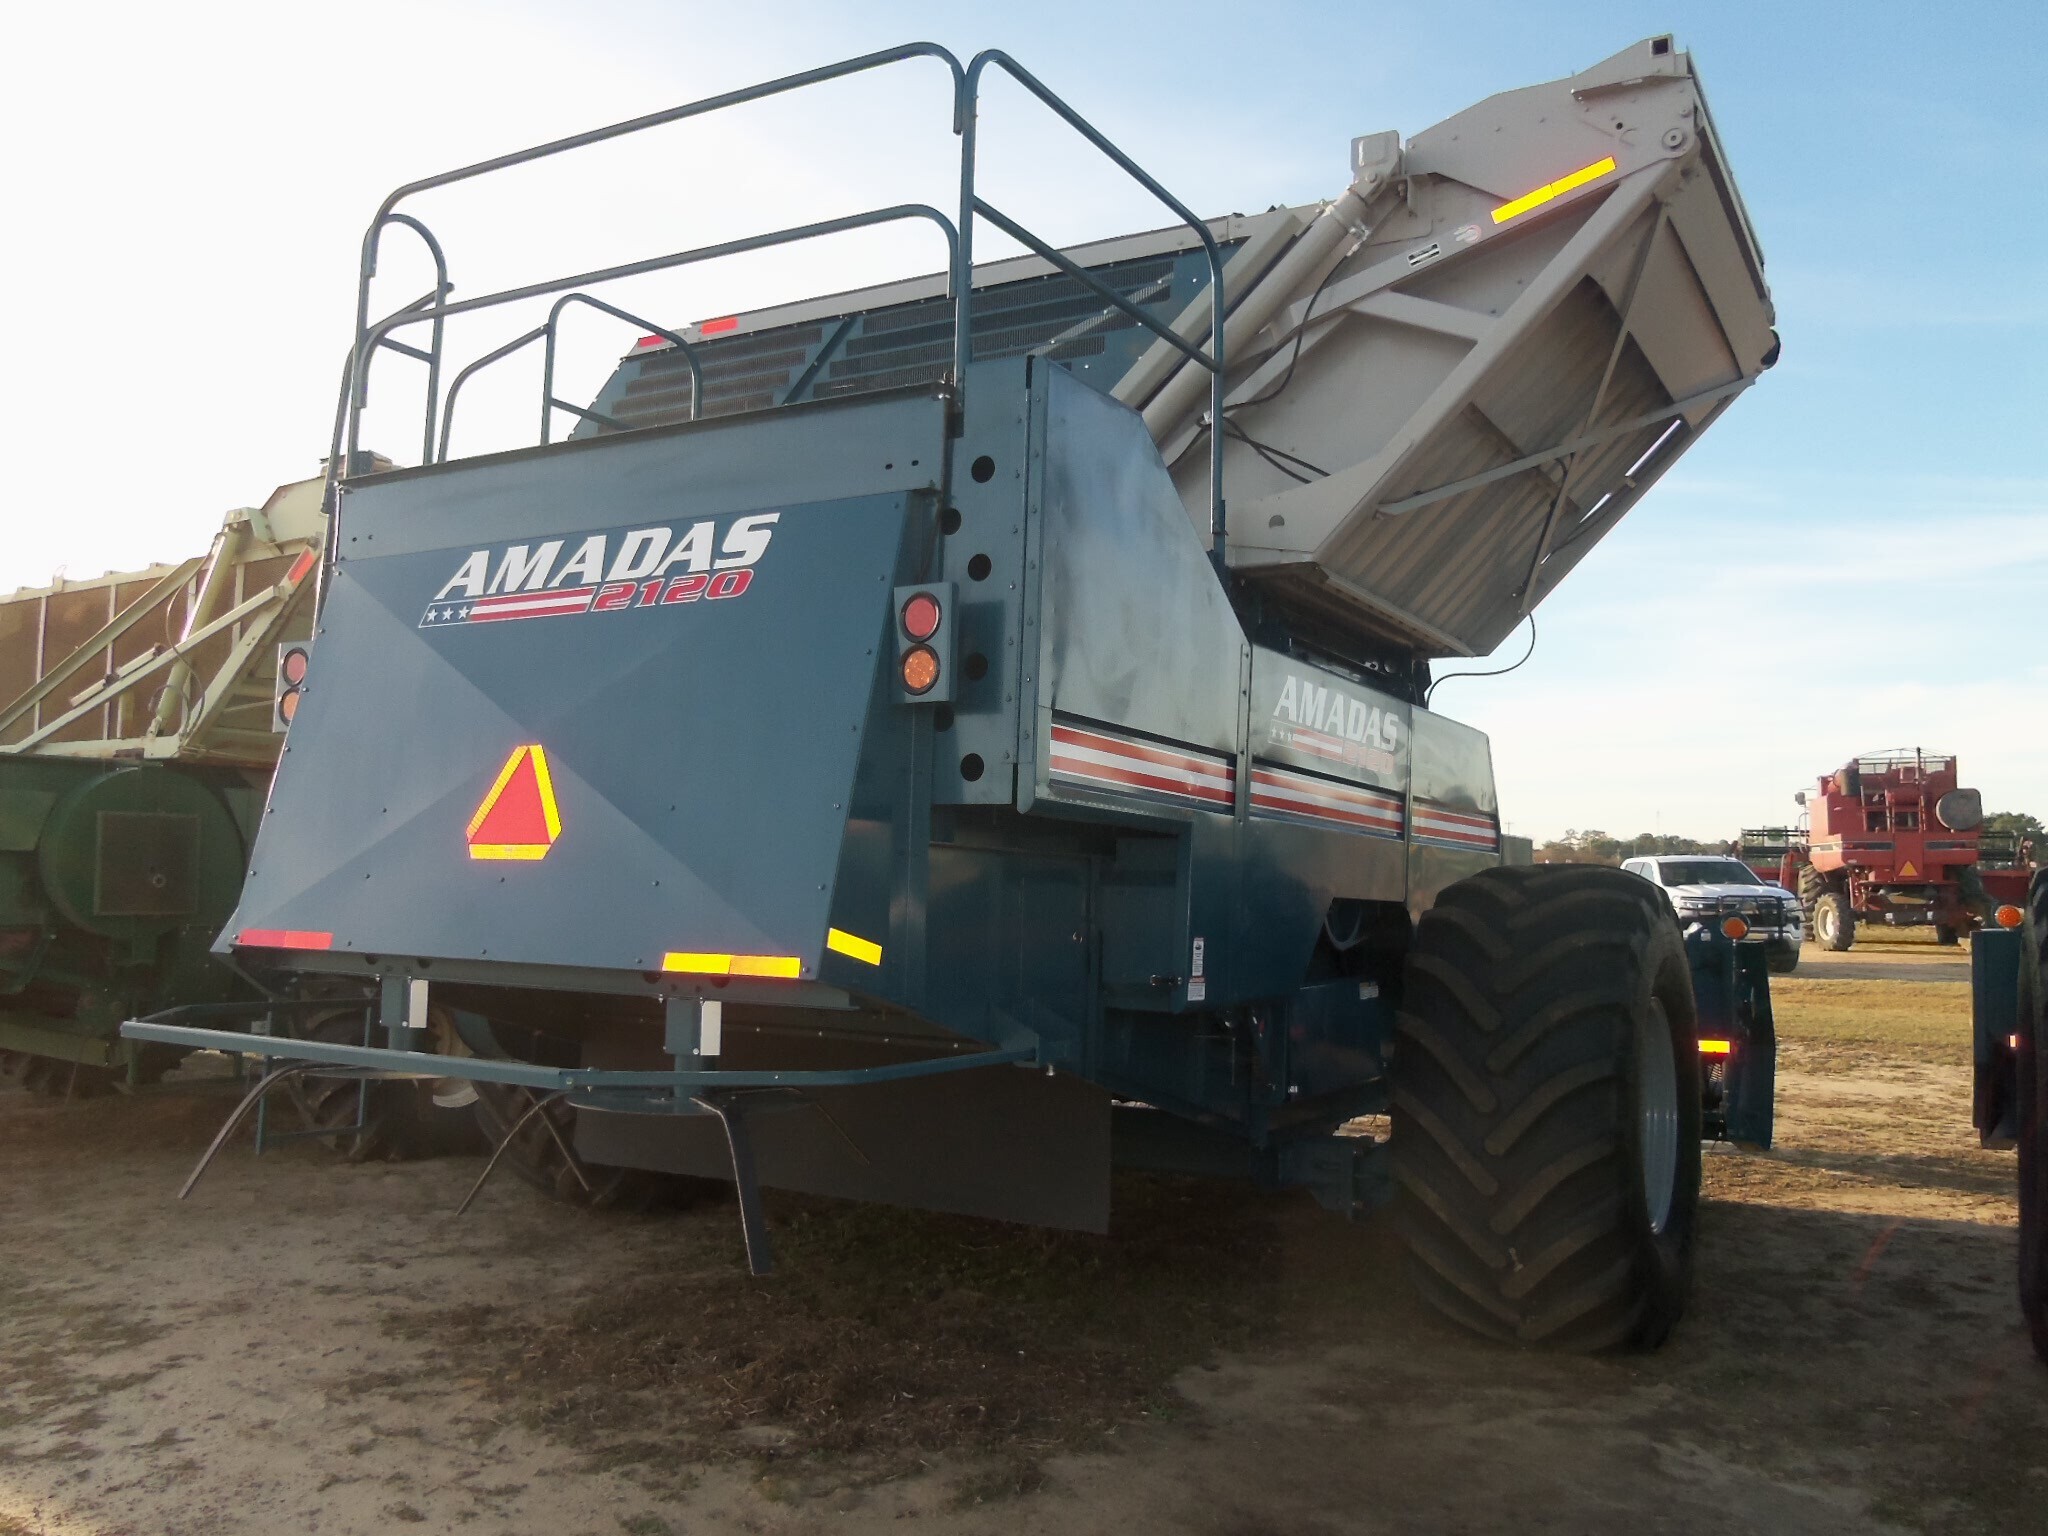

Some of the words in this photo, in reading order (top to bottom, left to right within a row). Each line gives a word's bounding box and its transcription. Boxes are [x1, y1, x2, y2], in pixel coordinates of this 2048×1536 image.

[433, 512, 780, 600] AMADAS
[591, 568, 754, 613] 2120
[1273, 675, 1399, 752] AMADAS
